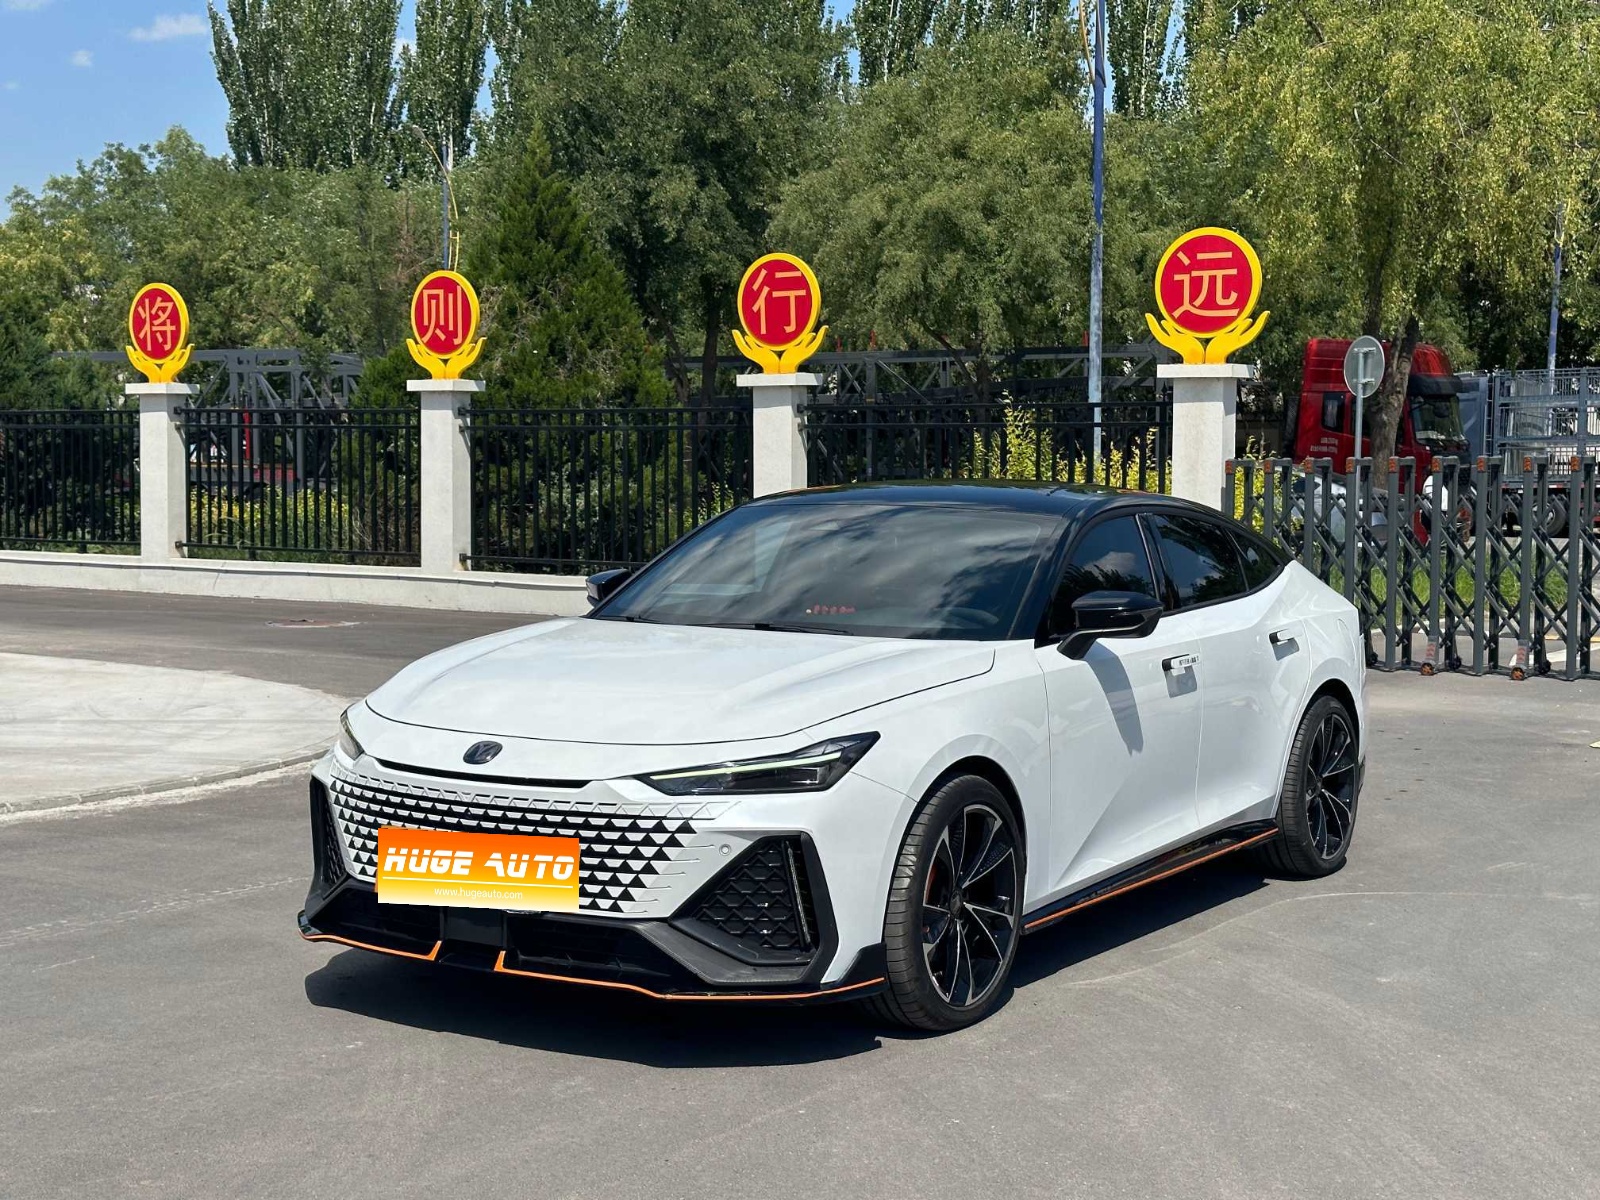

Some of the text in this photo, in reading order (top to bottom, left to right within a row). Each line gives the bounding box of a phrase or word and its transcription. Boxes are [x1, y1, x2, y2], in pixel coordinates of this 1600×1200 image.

[421, 284, 464, 346] 则
[751, 267, 807, 335] 行
[1172, 250, 1239, 318] 远
[137, 296, 176, 352] 将
